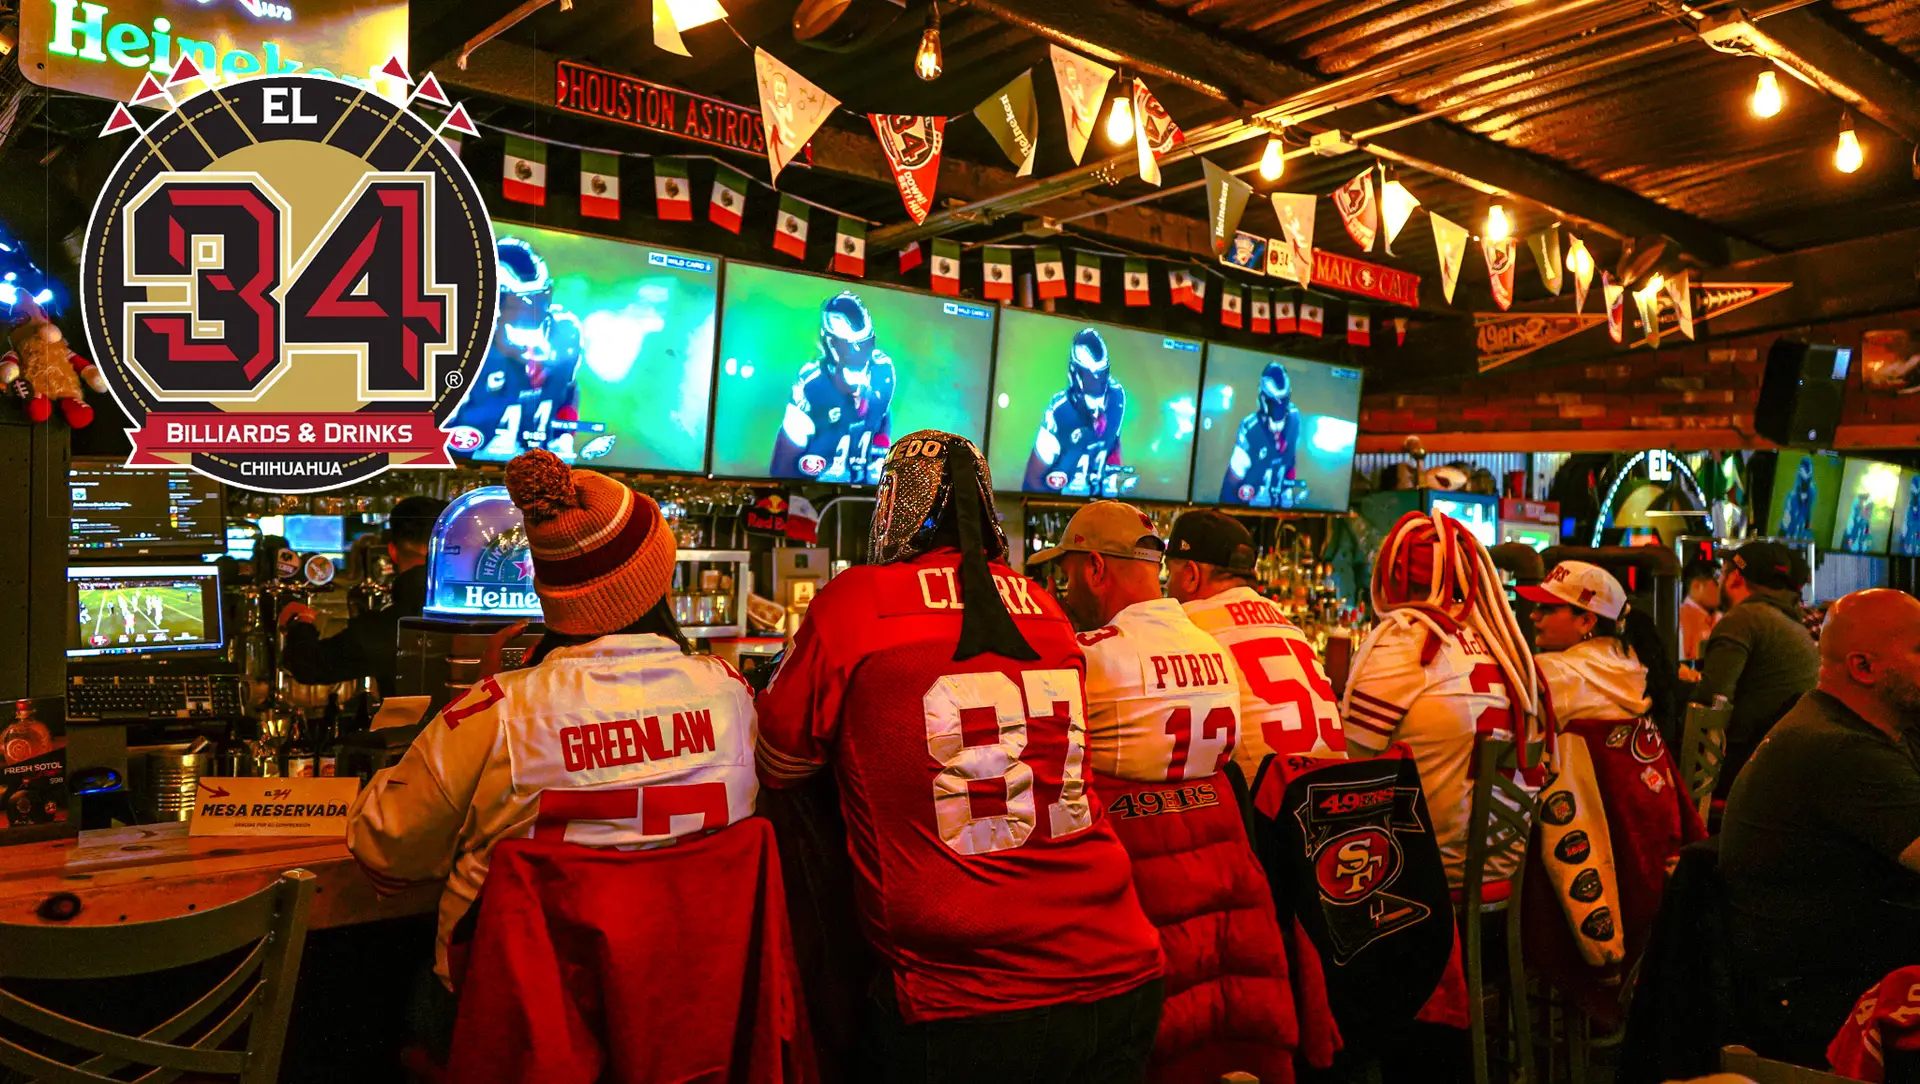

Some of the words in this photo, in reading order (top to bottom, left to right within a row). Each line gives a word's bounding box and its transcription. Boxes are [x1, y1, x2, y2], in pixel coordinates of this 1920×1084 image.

[49, 0, 384, 88] Heinek
[570, 69, 675, 131] HOUSTON
[684, 99, 765, 152] ASTROS
[999, 93, 1035, 157] Heineken
[1215, 180, 1230, 237] Heineken
[1317, 256, 1352, 287] MAN
[1379, 271, 1414, 302] CAVE
[1649, 450, 1672, 481] EL
[747, 512, 773, 529] Red
[465, 586, 541, 609] Heine
[917, 567, 1042, 615] CLRK
[1456, 631, 1490, 656] McC
[1150, 653, 1229, 689] PURDY
[1230, 637, 1348, 753] 55
[559, 709, 716, 773] GREENLAW
[4, 765, 33, 775] FRESH
[34, 762, 63, 772] SOTOL
[922, 668, 1092, 856] 87
[201, 804, 247, 817] MESA
[251, 804, 347, 817] RESERVADA
[1108, 784, 1217, 819] 49ERS
[1320, 787, 1396, 815] 49ERS
